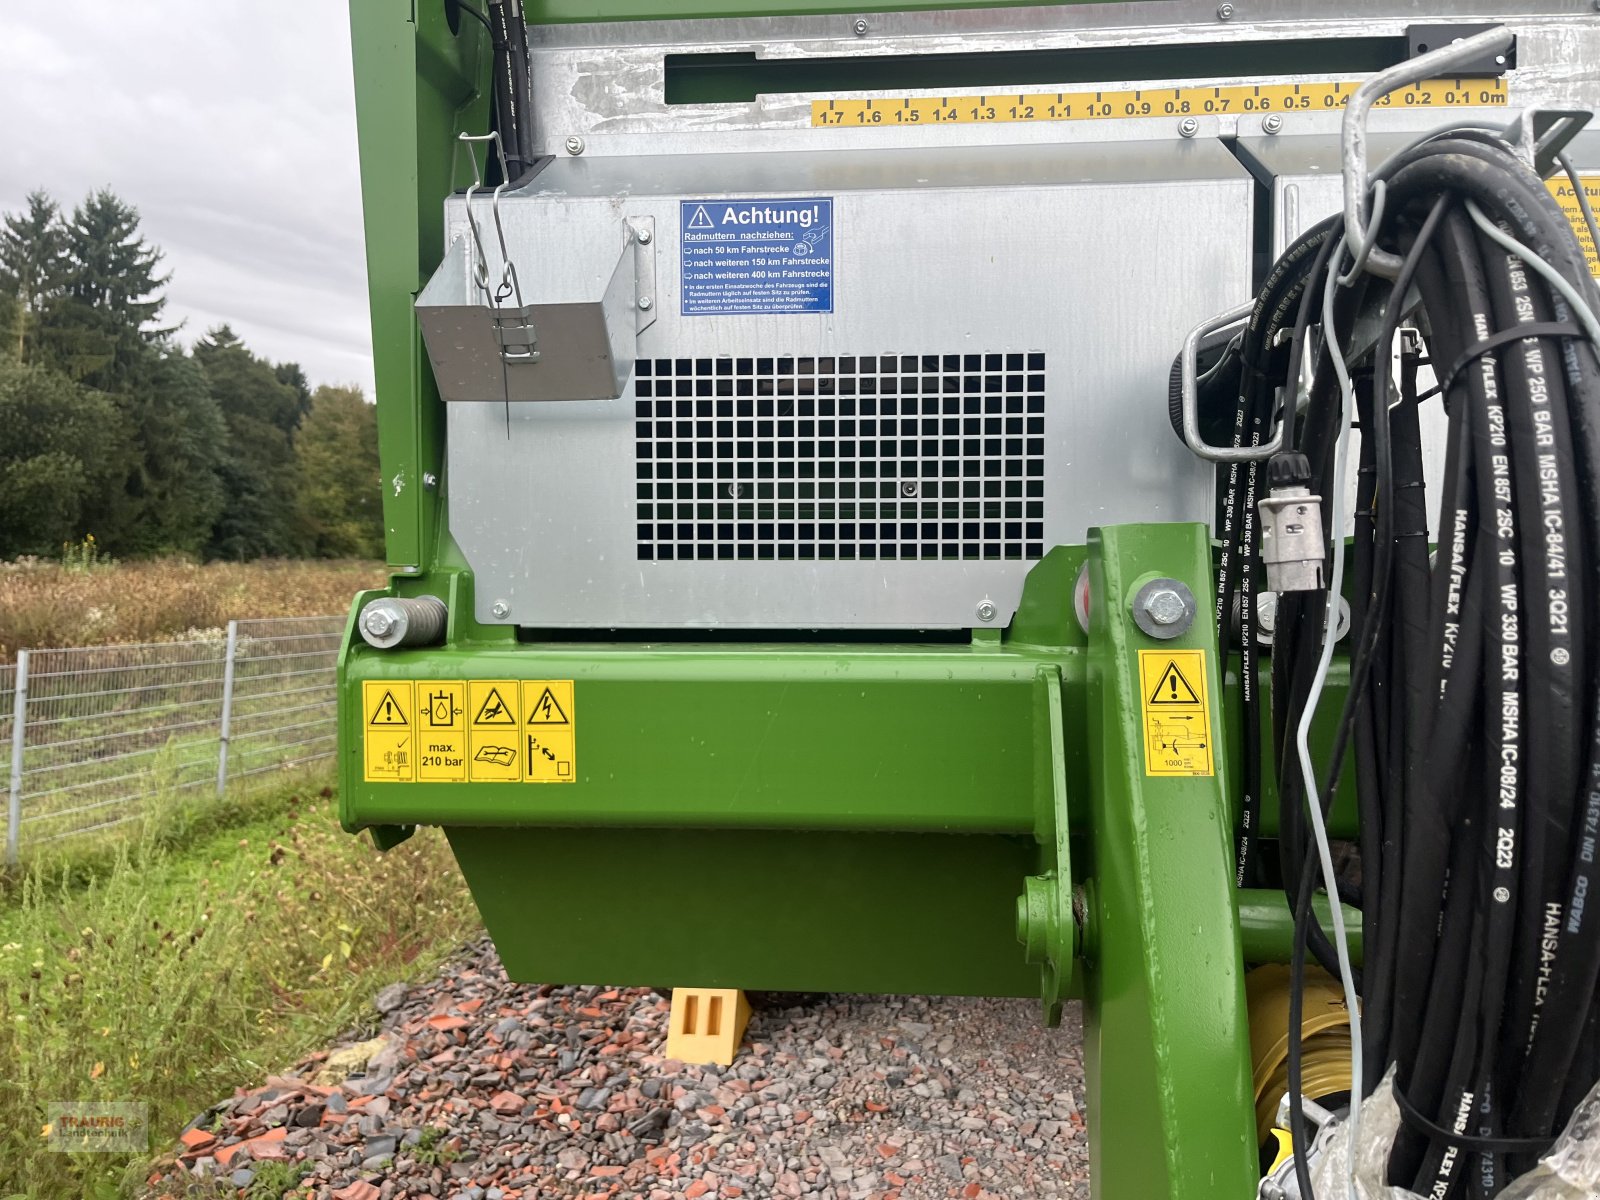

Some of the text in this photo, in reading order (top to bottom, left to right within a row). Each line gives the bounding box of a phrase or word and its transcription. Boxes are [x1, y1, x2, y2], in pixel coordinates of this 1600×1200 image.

[820, 112, 844, 124] 1.7
[857, 111, 882, 123] 1.6
[894, 110, 920, 122] 1.5
[932, 108, 958, 121] 1.4
[970, 108, 996, 120] 1.3
[1008, 106, 1034, 119] 1.2
[1048, 105, 1072, 118] 1.1
[1086, 103, 1112, 116] 1.0
[1125, 102, 1151, 115] 0.9
[1164, 100, 1190, 113] 0.8
[1204, 100, 1230, 112] 0.7
[1244, 98, 1270, 110] 0.6
[1284, 96, 1310, 109] 0.5
[1324, 94, 1350, 107] 0.4
[1404, 92, 1431, 105] 0.2
[1445, 91, 1470, 104] 0.1
[1480, 90, 1505, 103] 0m
[1556, 186, 1600, 196] Actu
[722, 206, 819, 228] Achtung!
[684, 232, 794, 241] Radmuttern nachziehen:
[741, 245, 789, 253] Fahrstrecke
[1510, 271, 1527, 290] 853
[1514, 296, 1535, 322] 2SN
[1523, 350, 1541, 373] WP
[1528, 377, 1548, 403] 250
[1534, 411, 1554, 446] BAR
[1248, 460, 1256, 486] IC-08/2
[1538, 455, 1560, 505] MSHA
[1247, 487, 1255, 509] MSHA
[1225, 517, 1232, 532] WP
[1223, 539, 1230, 547] 10
[1244, 541, 1250, 557] WP
[1544, 510, 1566, 578] IC-84/41
[1243, 564, 1250, 572] 10
[1218, 583, 1225, 593] EN
[1474, 314, 1519, 869] HAN//FLEX KP210 EN 857 2SC 10 WP 330 BAR MSHA IC-08/24 2Q23
[1242, 609, 1249, 620] EN
[1549, 590, 1568, 634] 3Q21
[429, 744, 455, 752] max.
[422, 756, 463, 766] 210 bar
[1584, 791, 1600, 833] 74310
[1581, 837, 1596, 862] DIN
[1567, 875, 1588, 934] WABCO
[1429, 1180, 1449, 1200] KP2
